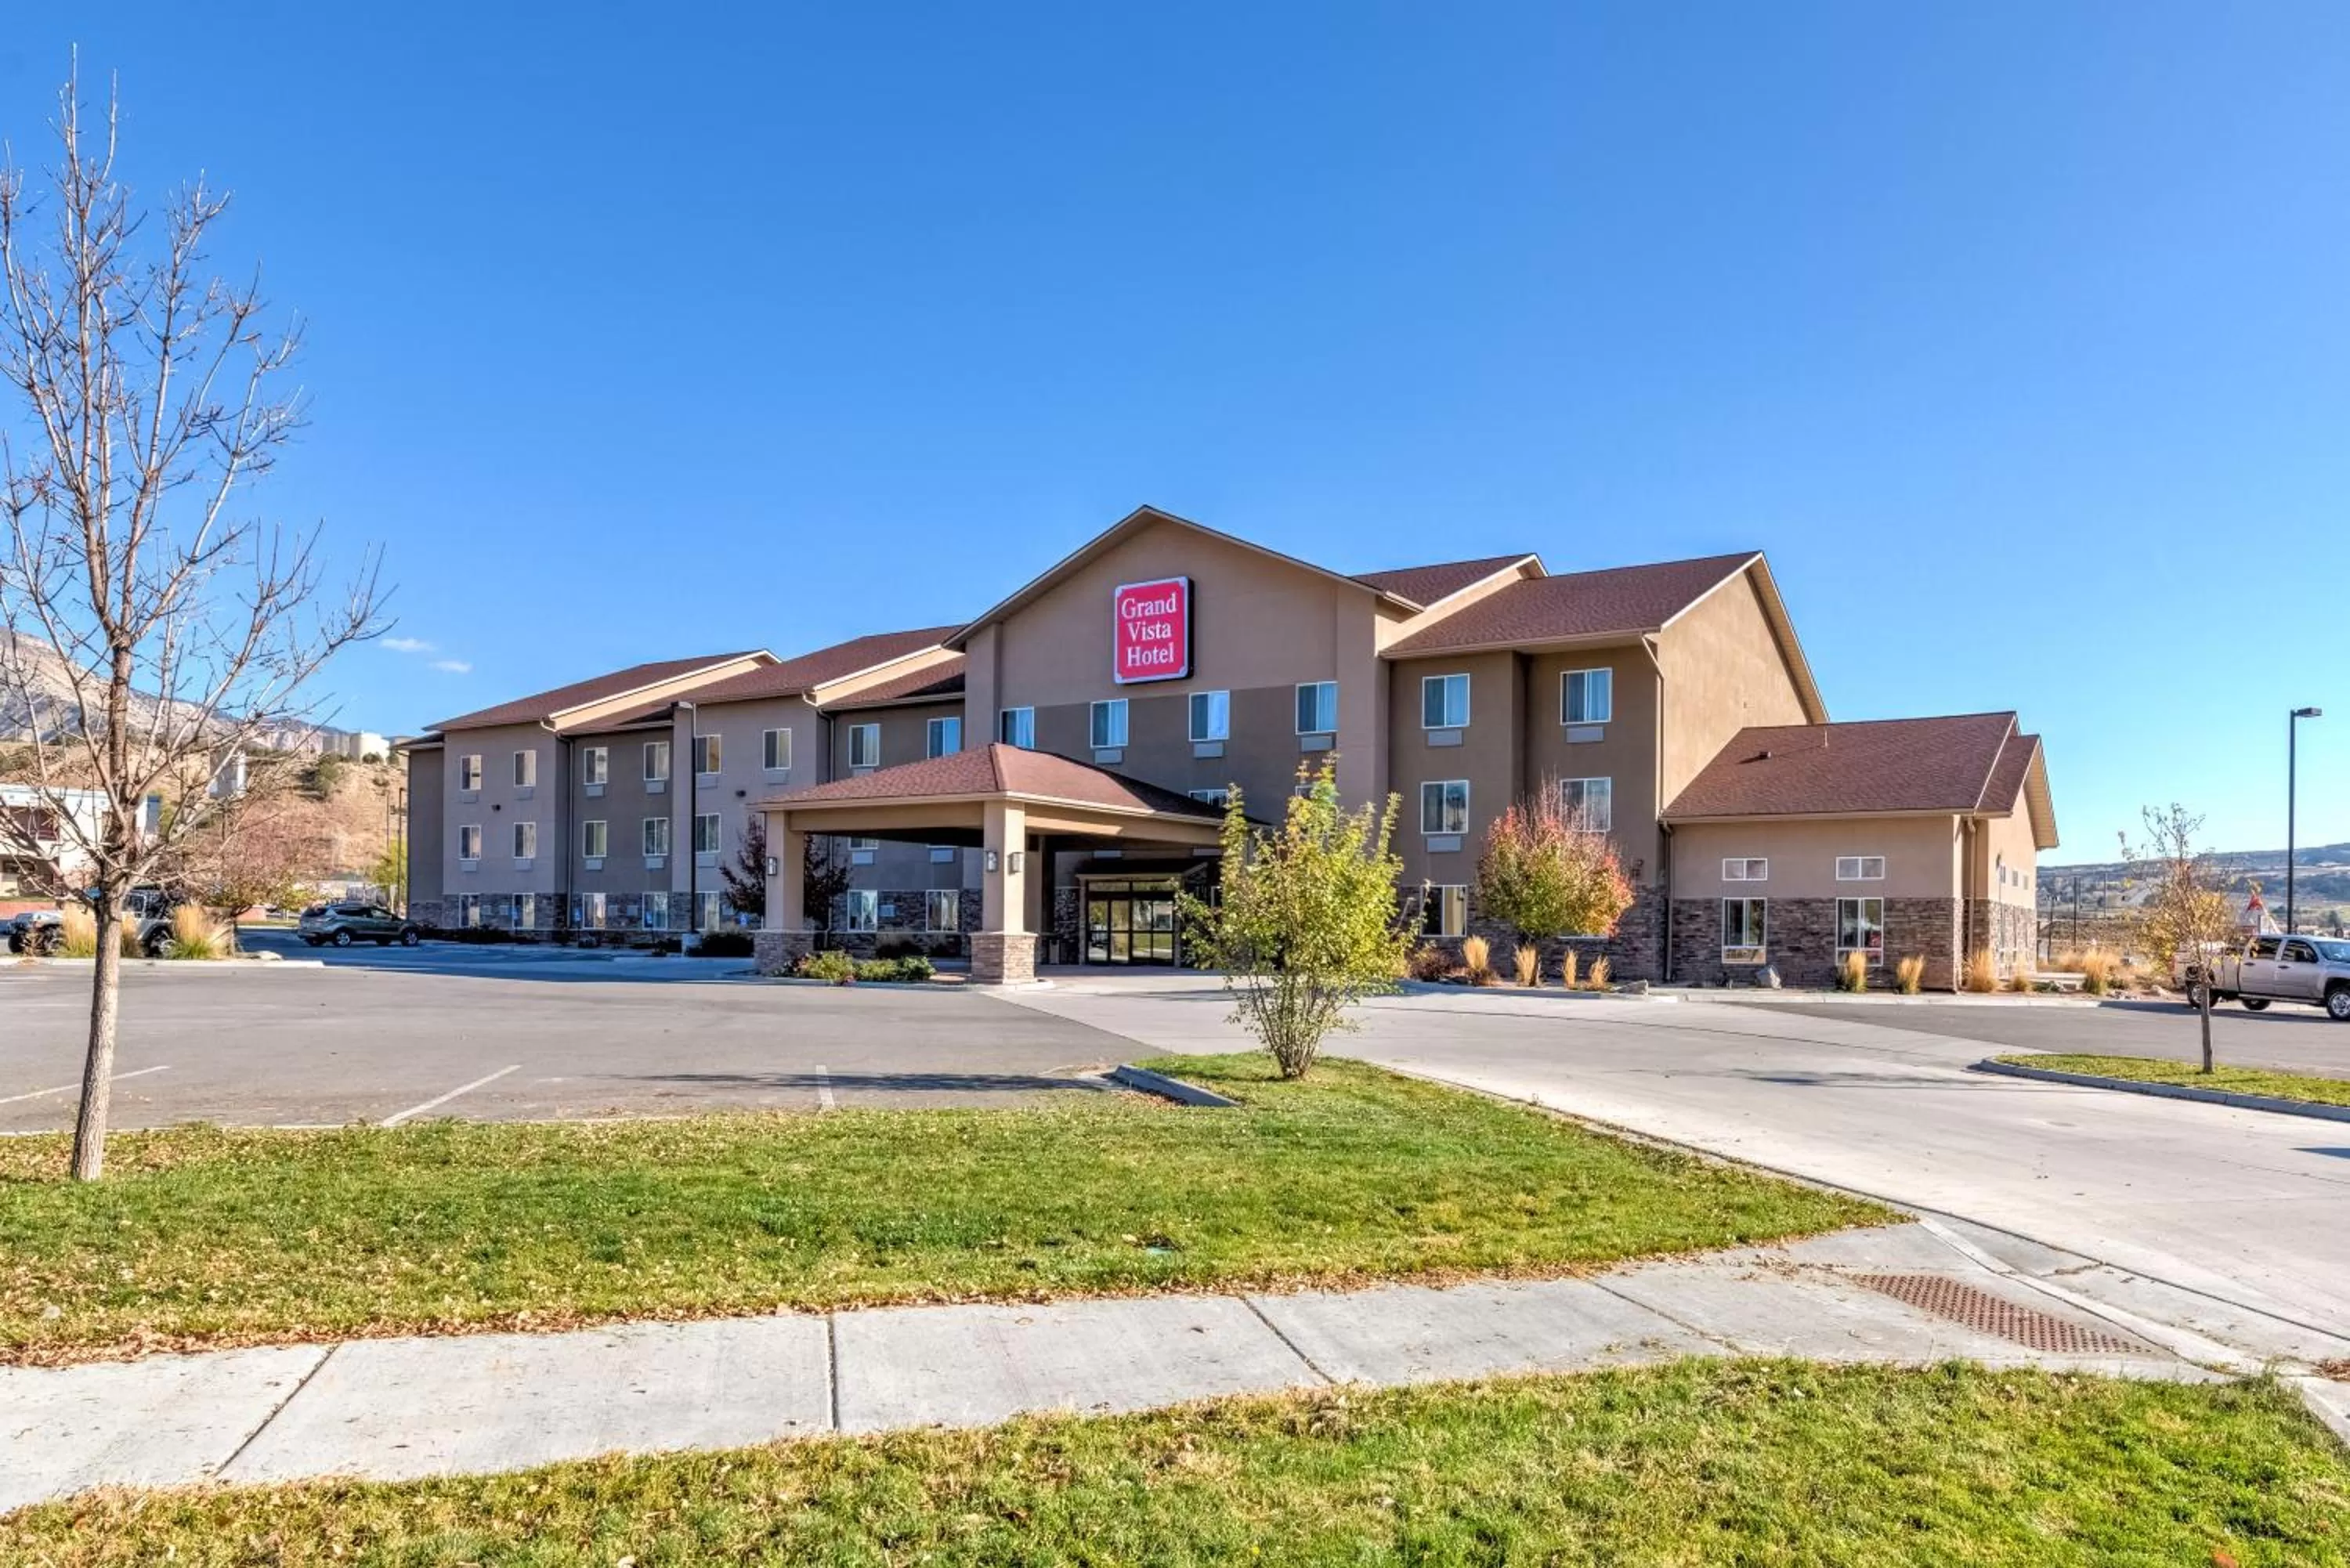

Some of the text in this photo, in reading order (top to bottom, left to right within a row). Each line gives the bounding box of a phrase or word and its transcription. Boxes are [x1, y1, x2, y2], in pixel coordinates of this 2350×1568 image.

[1121, 592, 1177, 619] Grand
[1128, 621, 1172, 641] Vista
[1126, 642, 1174, 667] Hotel
